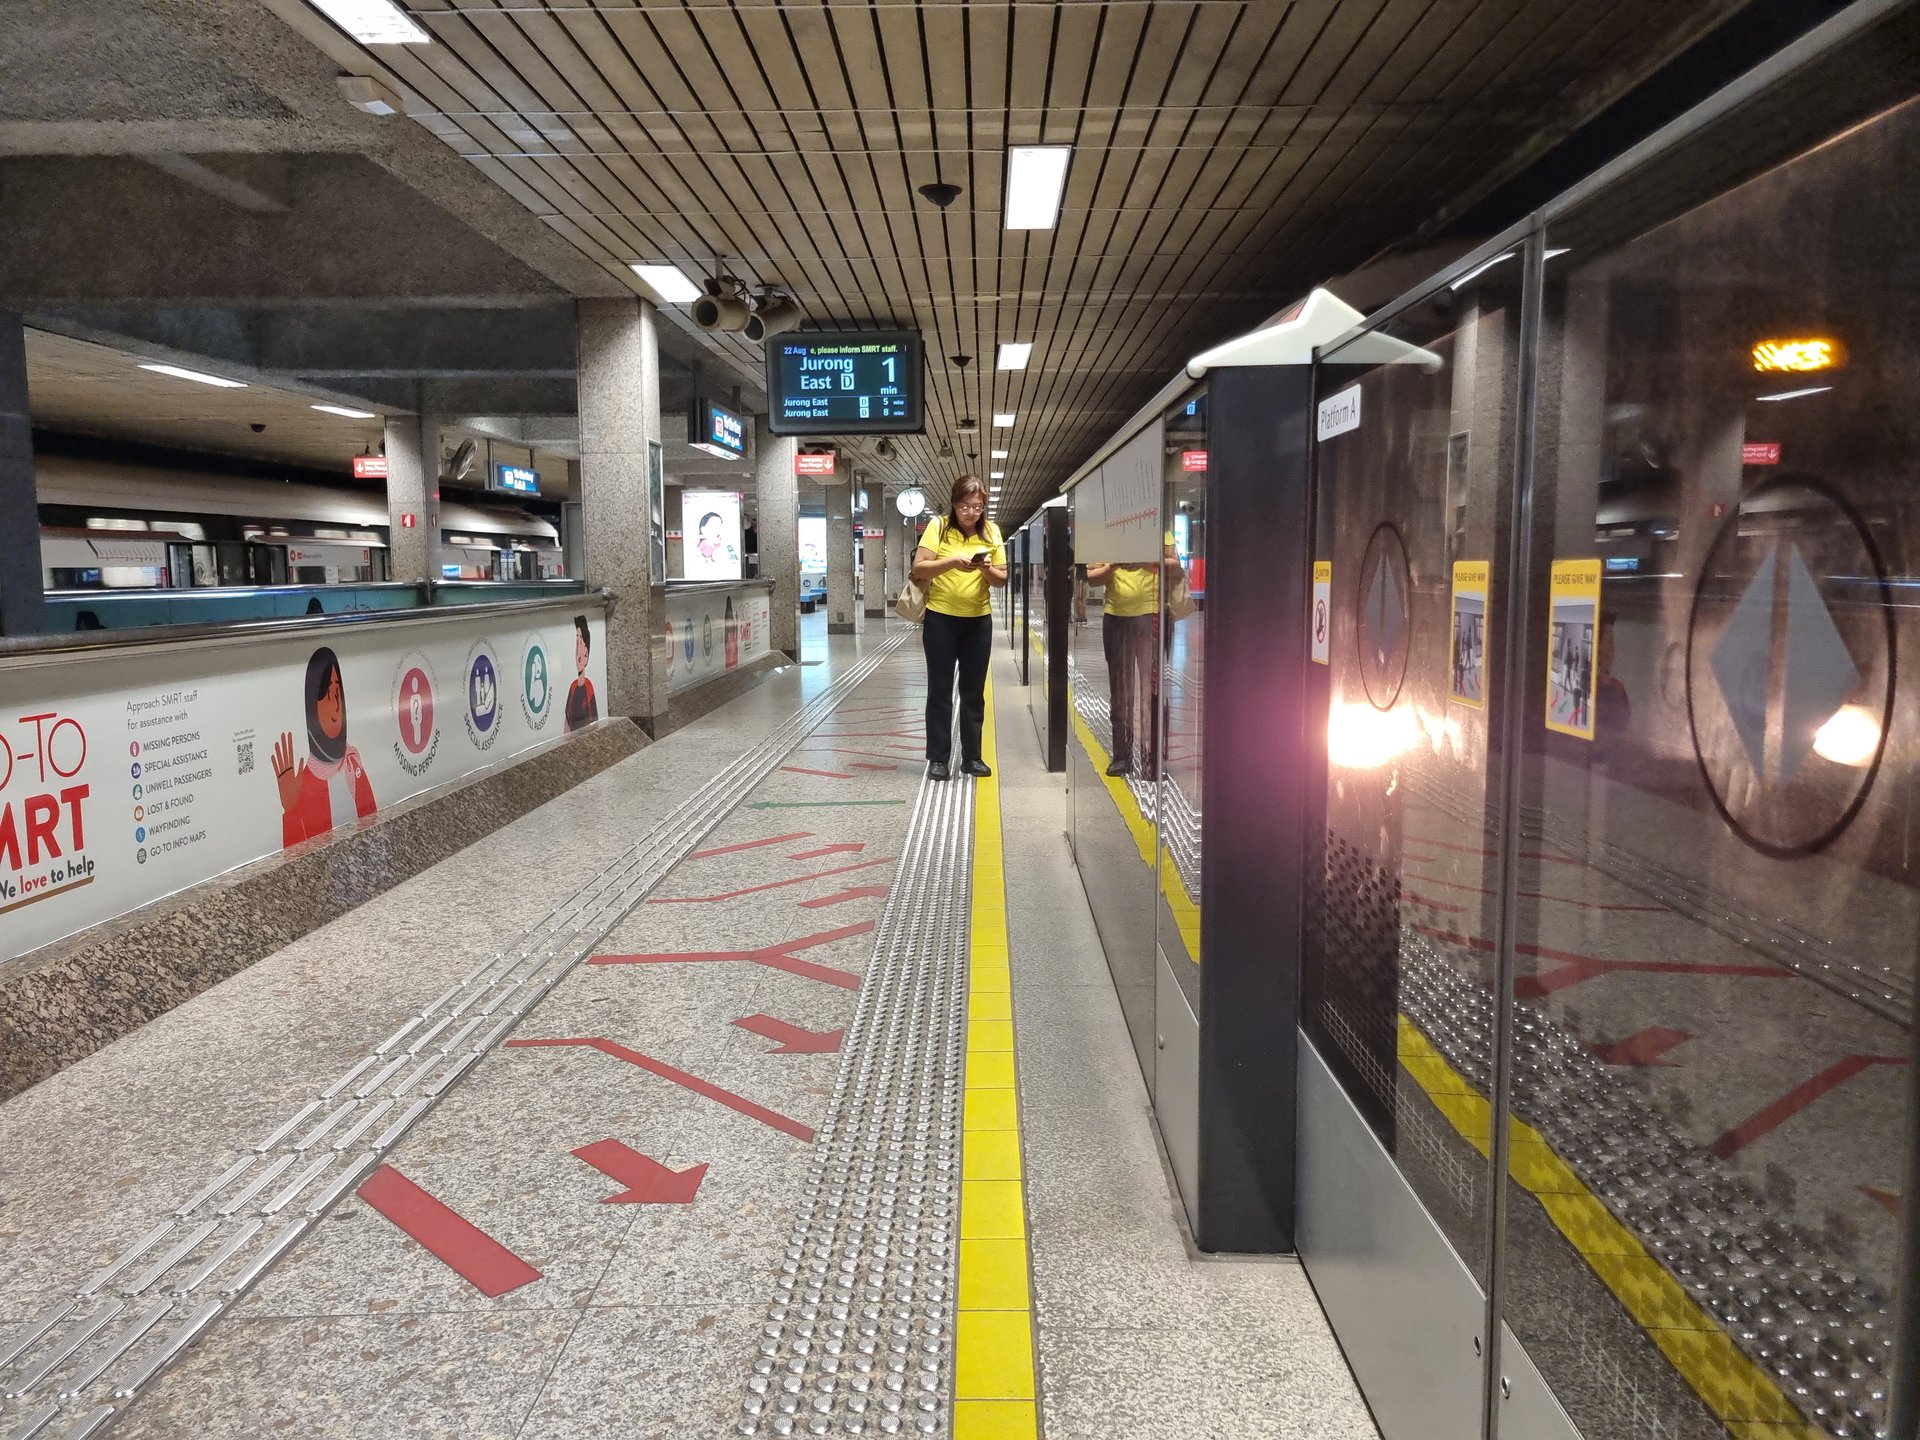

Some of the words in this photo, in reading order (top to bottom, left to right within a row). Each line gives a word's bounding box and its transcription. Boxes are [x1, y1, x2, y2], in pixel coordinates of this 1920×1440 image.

[784, 346, 792, 355] 22
[793, 346, 807, 356] Aug
[817, 346, 838, 355] please
[839, 345, 860, 354] inform
[861, 345, 880, 353] SMRT
[881, 345, 898, 353] staff.
[799, 356, 853, 373] Jurong
[882, 357, 895, 383] 1
[800, 375, 832, 390] East
[842, 375, 853, 389] D
[880, 386, 897, 395] min
[783, 398, 810, 408] Jurong
[812, 398, 828, 406] East
[883, 398, 889, 406] 5
[783, 409, 811, 418] Jurong
[812, 409, 829, 417] East
[883, 409, 889, 417] 8
[1320, 404, 1348, 431] Platform
[1351, 396, 1356, 420] A
[1455, 572, 1467, 582] PLEASE
[1468, 572, 1477, 581] GIVE
[1477, 573, 1486, 582] WAY
[1554, 574, 1571, 585] PLEASE
[1571, 574, 1583, 584] GIVE
[1584, 573, 1596, 584] WAY
[126, 697, 160, 715] Approach
[161, 692, 182, 707] SMRT
[184, 690, 198, 703] staff
[520, 694, 534, 730] UNWELL
[534, 687, 553, 731] PASSENGERS
[127, 718, 138, 731] for
[140, 715, 173, 728] assistance
[174, 710, 188, 721] with
[463, 713, 481, 750] SPECIAL
[481, 704, 503, 751] ASSISTANCE
[143, 737, 171, 752] MISSING
[171, 731, 200, 745] PERSONS
[144, 758, 171, 773] SPECIAL
[172, 749, 208, 765] ASSISTANCE
[393, 742, 418, 777] MISSING
[418, 729, 441, 775] PERSONS
[145, 779, 173, 794] UNWELL
[174, 768, 213, 786] PASSENGERS
[147, 802, 163, 815] LOST
[164, 800, 170, 810] &
[170, 794, 194, 808] FOUND
[149, 816, 191, 836] WAYFINDING
[150, 842, 172, 857] GO-TO
[173, 836, 188, 849] INFO
[190, 830, 207, 843] MAPS
[20, 875, 47, 895] love
[51, 869, 64, 883] to
[67, 855, 95, 879] help
